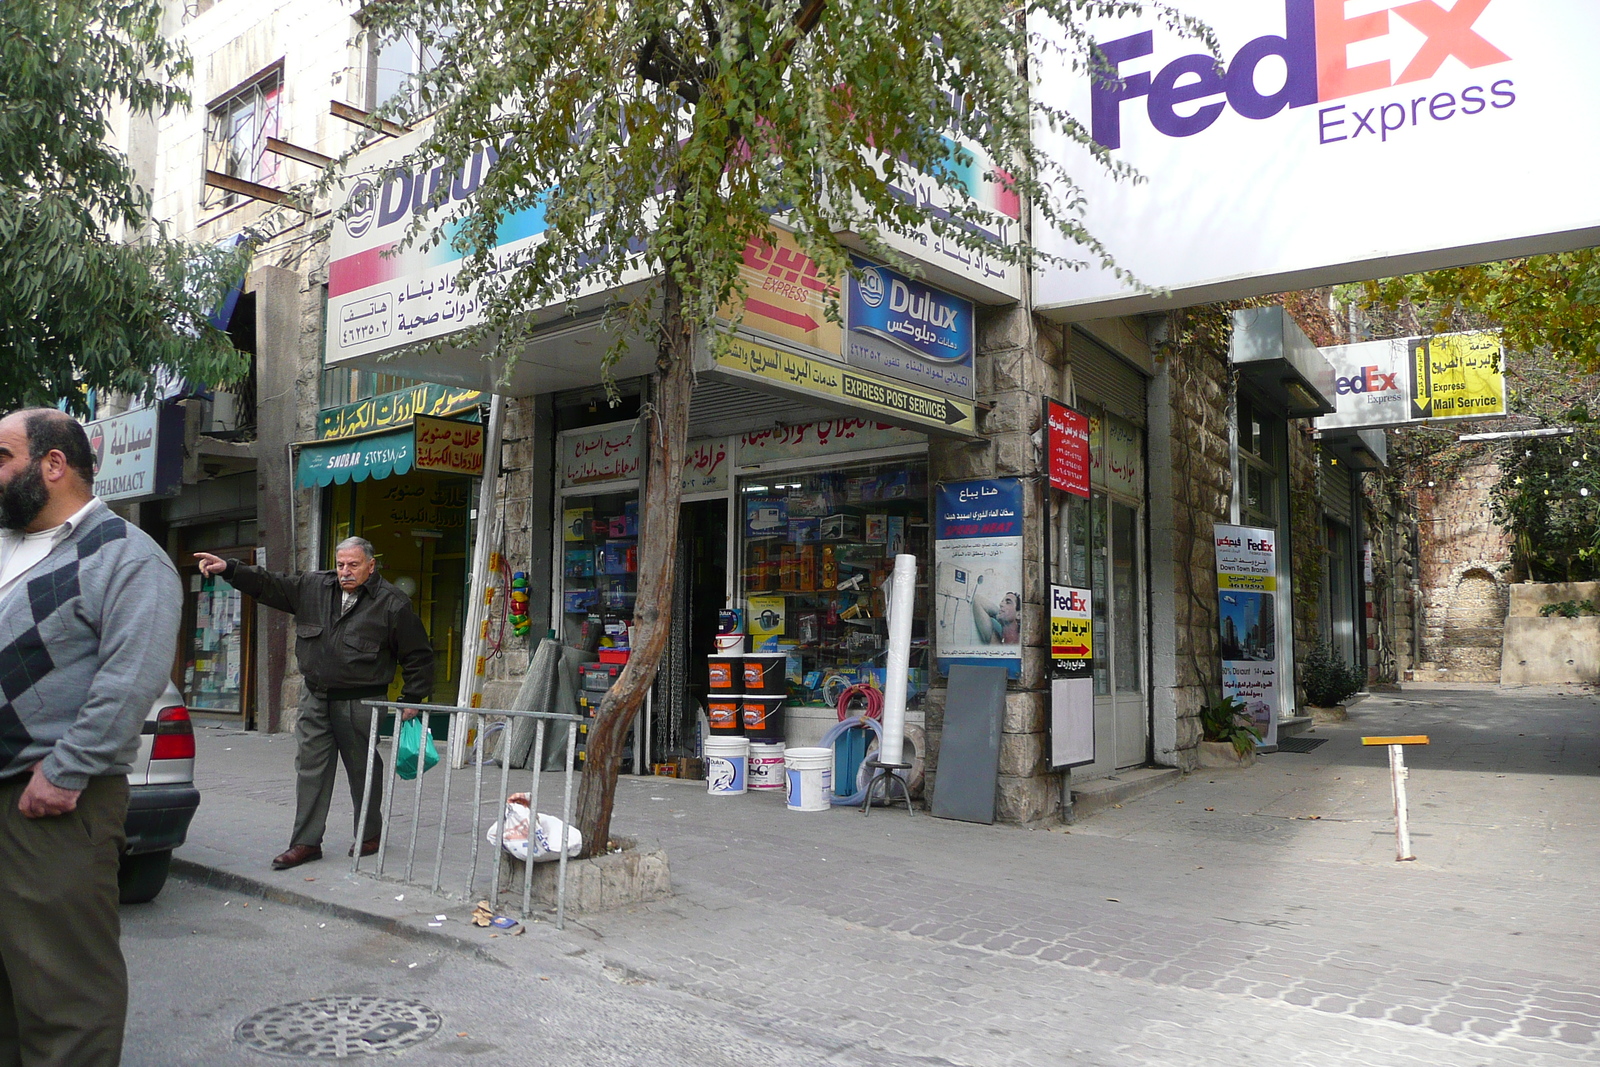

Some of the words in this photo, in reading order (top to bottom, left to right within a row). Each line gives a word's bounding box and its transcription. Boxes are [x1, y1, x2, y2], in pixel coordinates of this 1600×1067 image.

[1090, 0, 1513, 150] FedEx
[1319, 78, 1517, 144] Express
[740, 233, 829, 293] DHL
[974, 255, 1006, 281] مواد
[397, 278, 434, 306] بناء
[762, 276, 809, 303] EXPRESS
[343, 302, 387, 323] هاتف
[889, 279, 958, 333] Dulux
[343, 319, 388, 344] ٤٦٢٣٥٠٢
[397, 312, 439, 336] صحية
[886, 320, 937, 345] ديلوكس
[749, 348, 782, 374] السريع
[783, 359, 811, 385] البريد
[813, 368, 838, 388] خدمات
[1334, 365, 1399, 396] edEx
[1433, 383, 1466, 394] Express
[845, 376, 885, 404] EXPRESS
[886, 389, 908, 409] POST
[908, 393, 947, 420] SERVICES
[1367, 393, 1402, 405] Express
[1433, 396, 1455, 410] Mail
[1457, 395, 1498, 409] Service
[109, 420, 153, 466] صيدلية
[452, 428, 481, 449] محلات
[604, 435, 632, 456] جميع
[326, 452, 361, 470] SNOBAR
[598, 456, 640, 477] الدهانات
[95, 471, 146, 497] PHARMACY
[959, 487, 979, 503] يباع
[981, 486, 998, 496] هنا
[944, 524, 979, 537] SPEED
[981, 521, 1014, 534] HEAT
[1247, 538, 1274, 553] FedEx
[1220, 564, 1236, 572] Down
[1236, 565, 1251, 573] Town
[1251, 566, 1270, 574] Branch
[1053, 588, 1087, 612] FedEx
